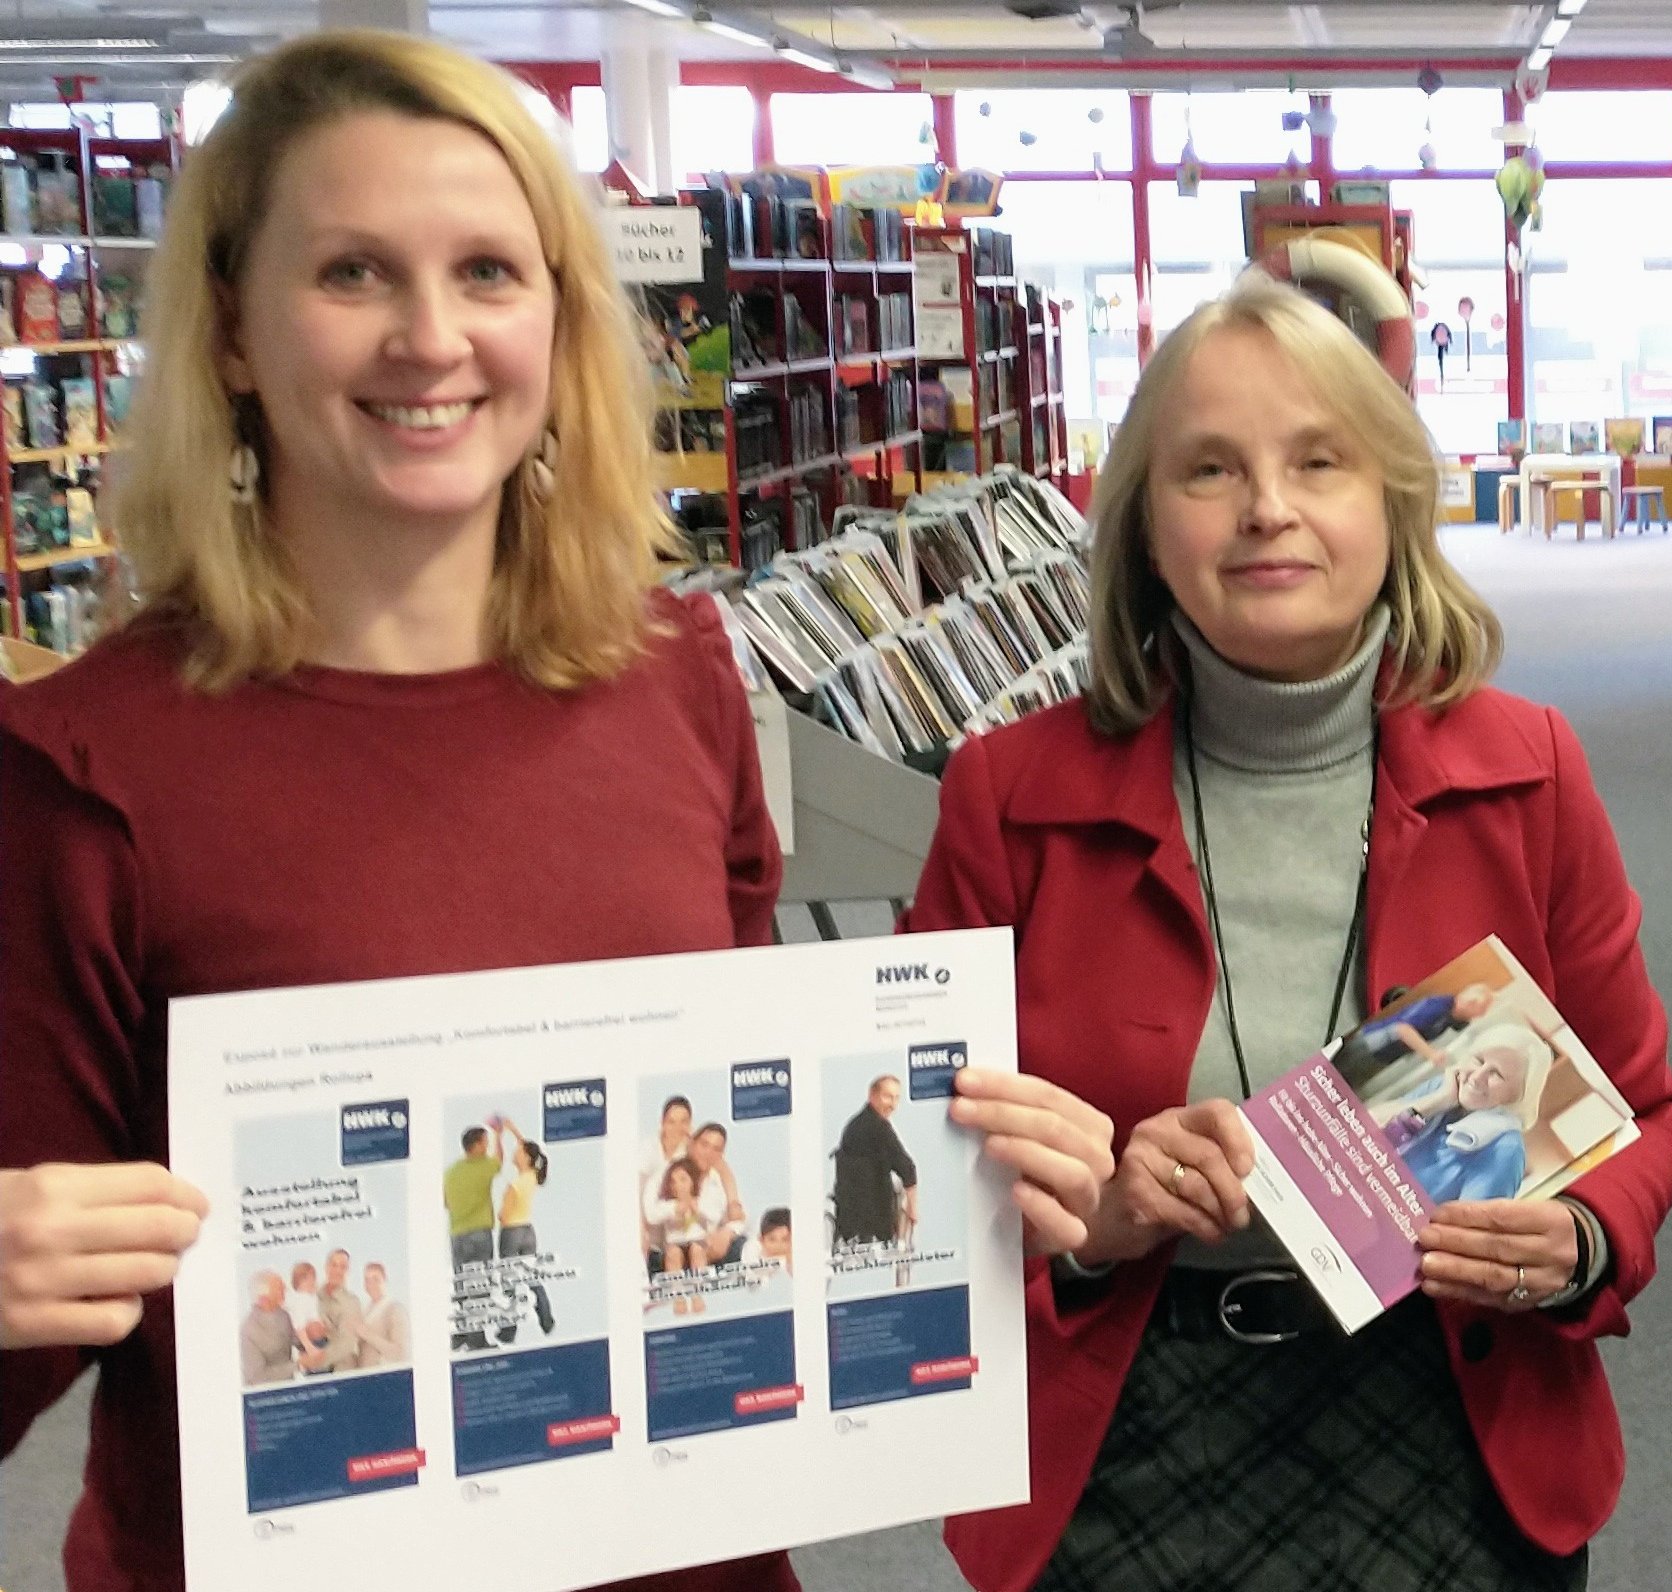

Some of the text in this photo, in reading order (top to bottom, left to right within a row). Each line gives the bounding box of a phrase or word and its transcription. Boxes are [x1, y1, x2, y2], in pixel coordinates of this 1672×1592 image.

[1294, 1075, 1419, 1243] Sturzunfälle sind vermeidbar
[1311, 1065, 1425, 1216] Sicher leben auch im Alter
